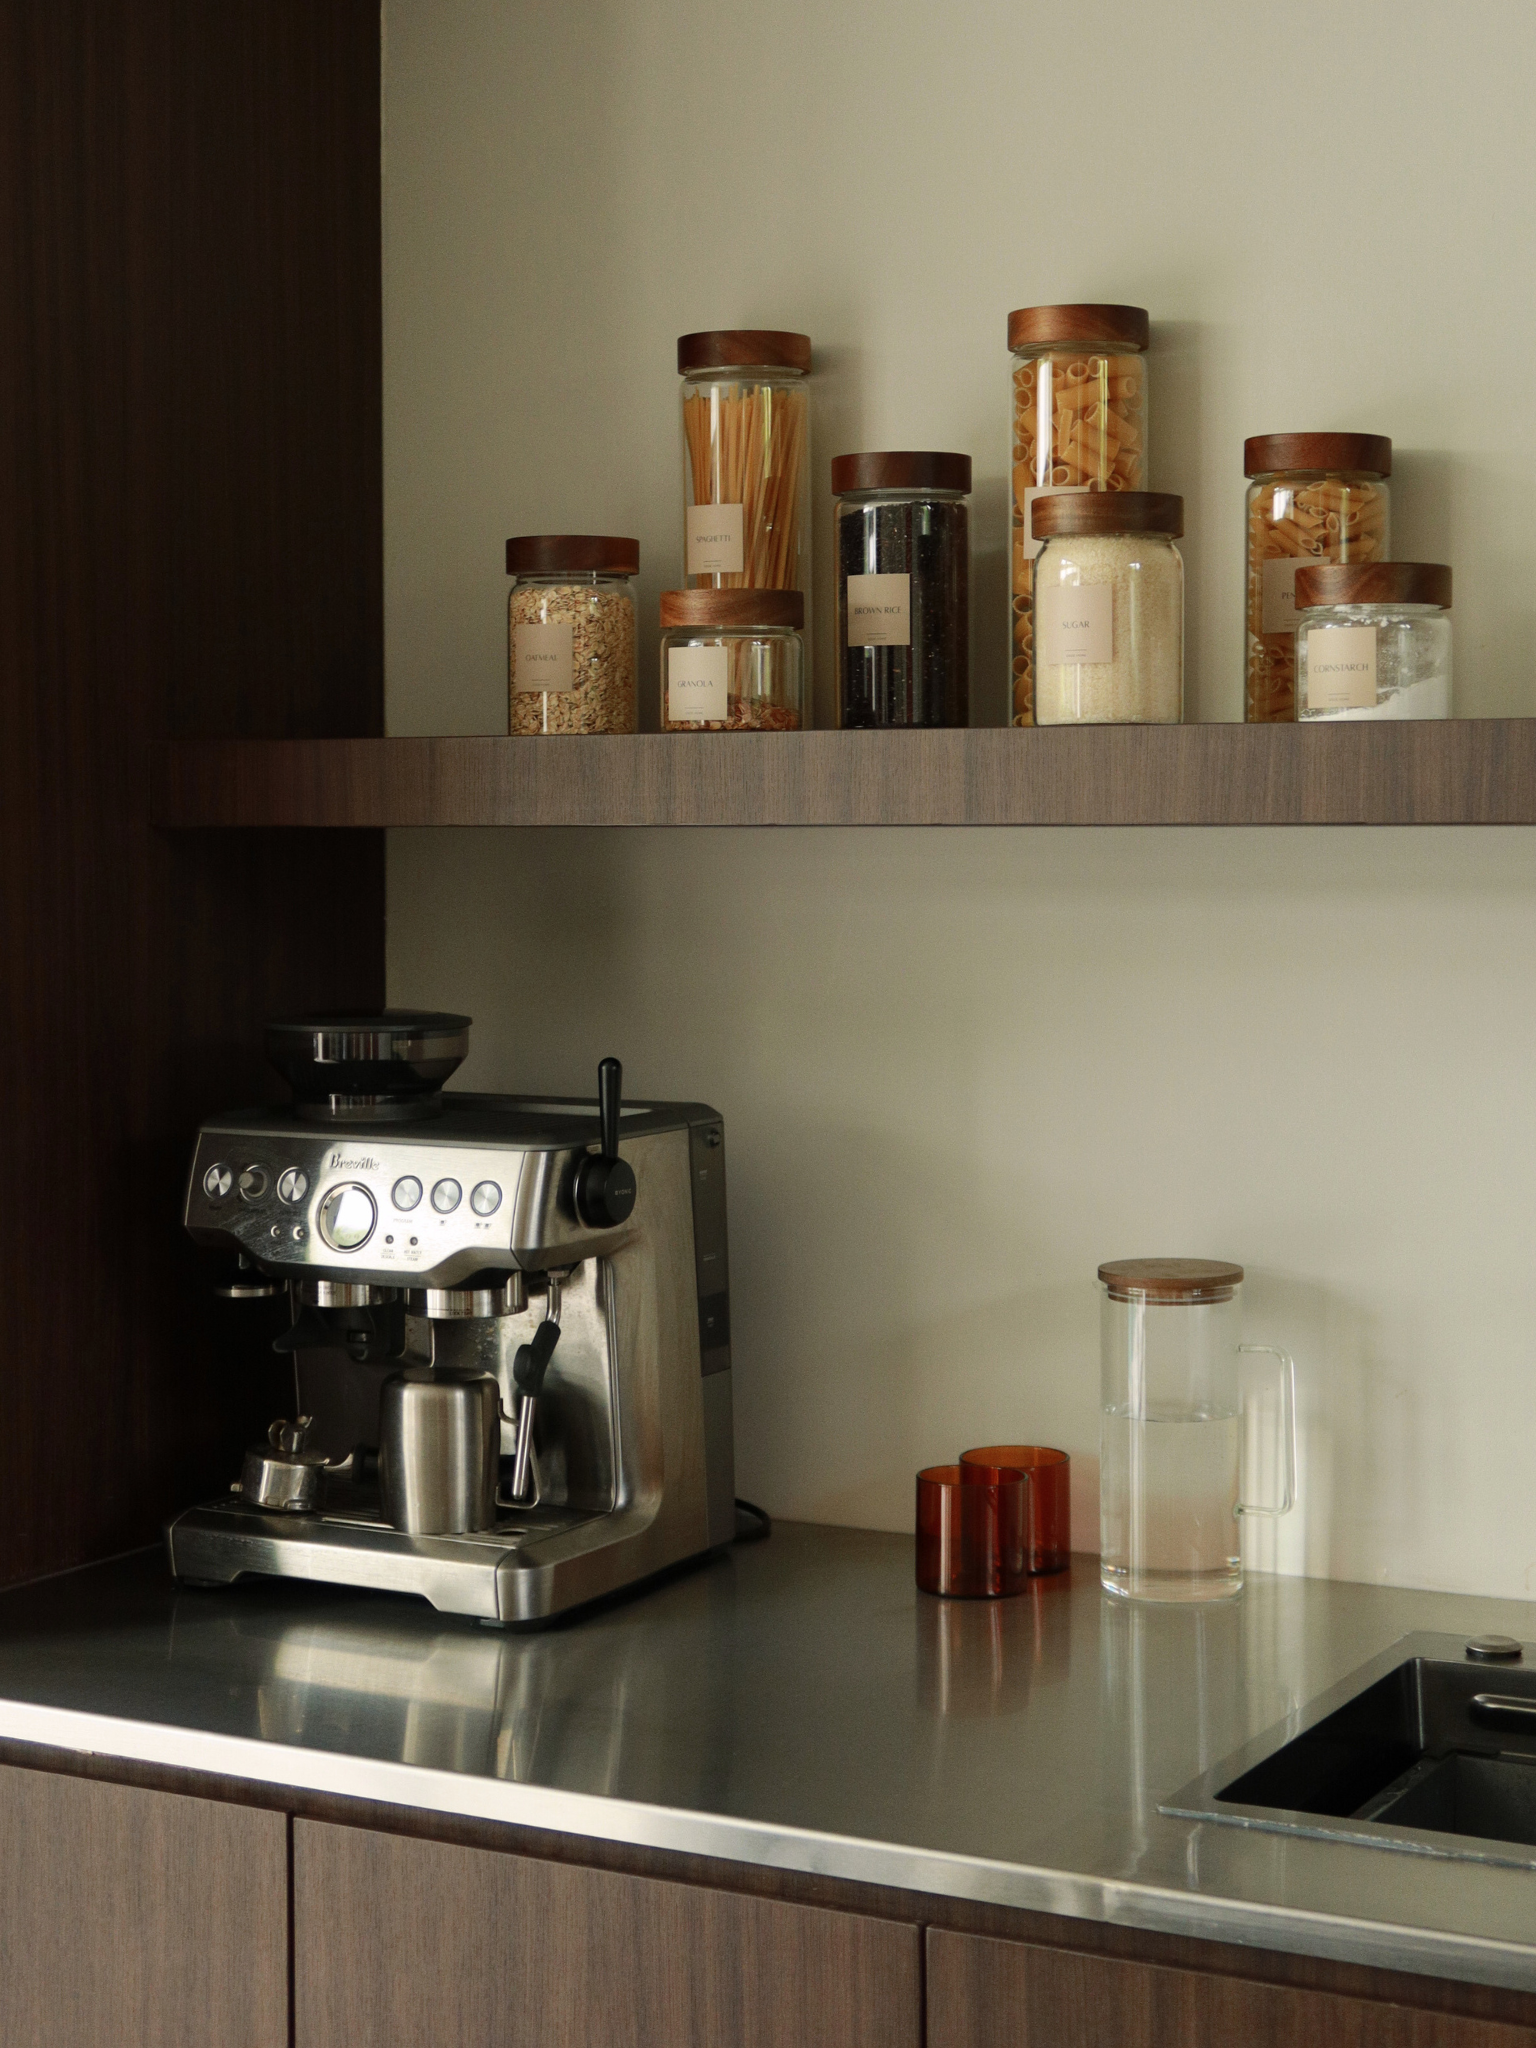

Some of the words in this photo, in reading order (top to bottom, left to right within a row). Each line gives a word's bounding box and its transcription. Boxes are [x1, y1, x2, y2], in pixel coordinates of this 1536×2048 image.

[695, 534, 731, 543] SPAGHETTI
[854, 606, 882, 615] BROWN
[884, 605, 901, 614] RICE
[1062, 620, 1090, 629] SUGAR
[525, 654, 557, 662] OATMEAL
[1313, 663, 1369, 674] CORNSTARCH
[677, 680, 714, 688] GRANOLA
[330, 1153, 380, 1171] Breville
